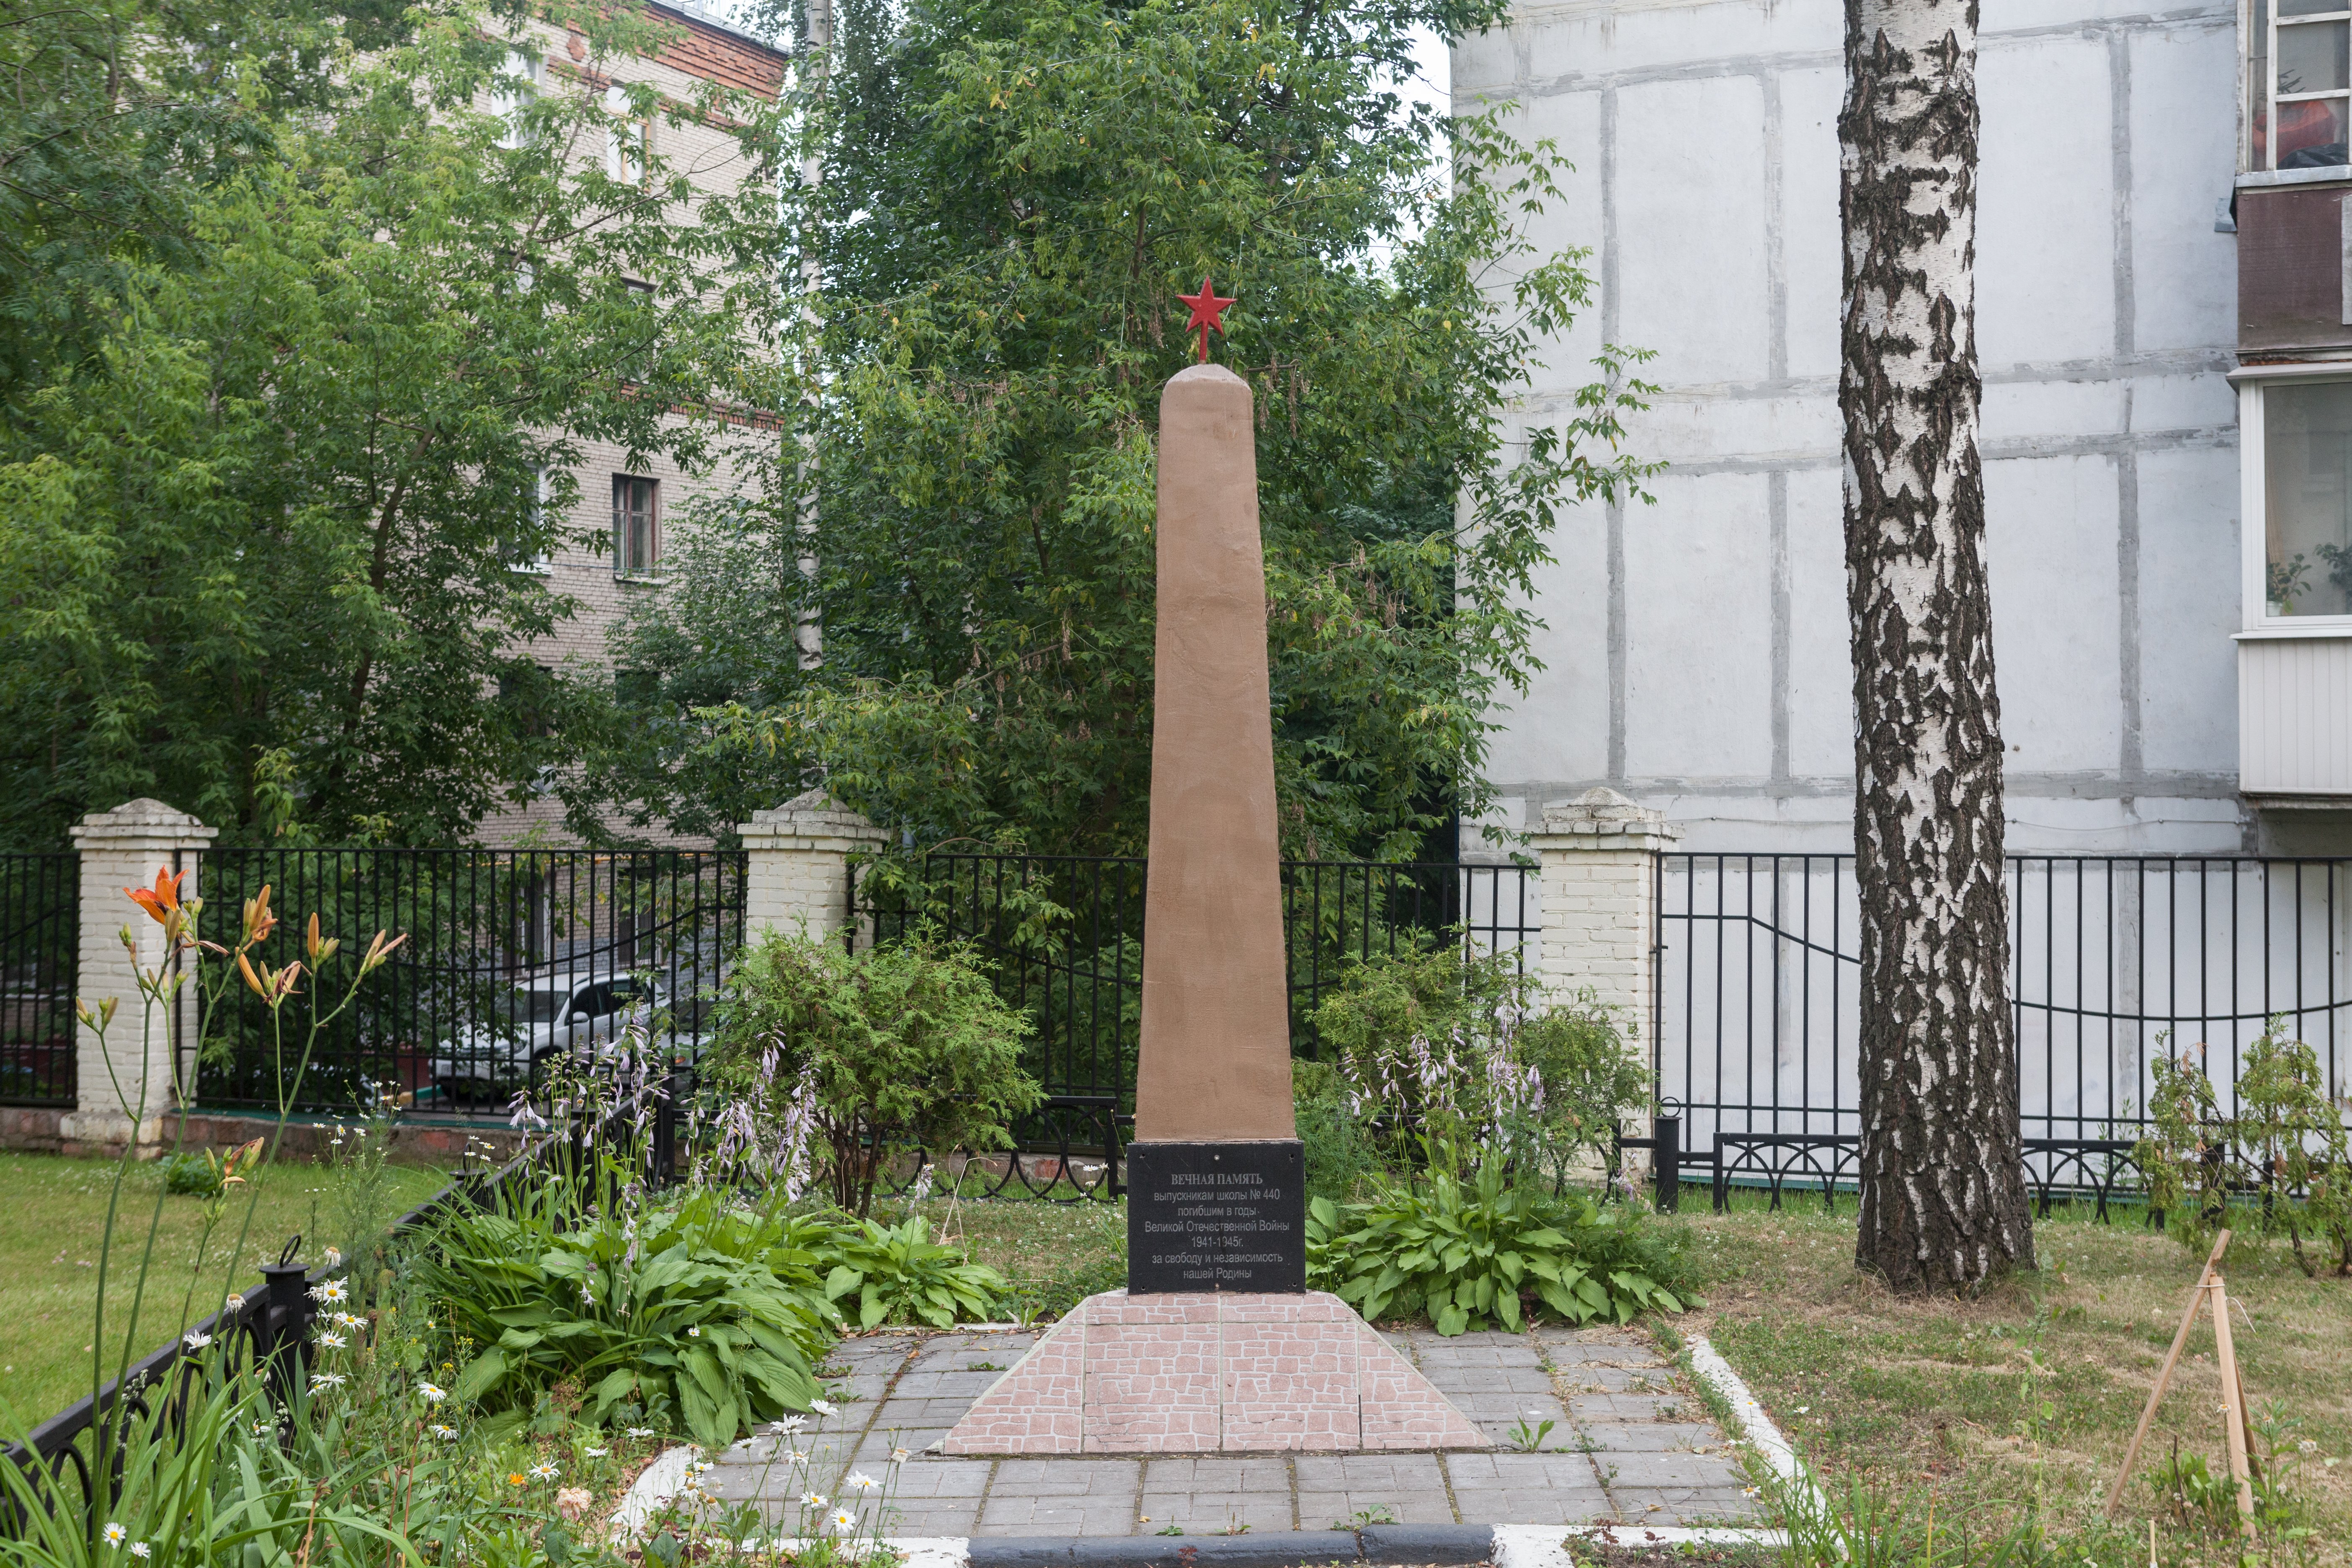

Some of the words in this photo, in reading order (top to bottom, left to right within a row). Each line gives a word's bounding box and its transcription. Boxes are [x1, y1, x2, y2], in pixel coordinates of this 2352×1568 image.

[1171, 1173, 1215, 1185] ВЕЧНАЯ
[1217, 1173, 1263, 1184] ПАМЯТЬ
[1154, 1191, 1214, 1203] выпускникам
[1217, 1191, 1247, 1200] школы
[1250, 1189, 1261, 1200] №
[1263, 1188, 1280, 1200] 440
[1178, 1204, 1224, 1216] погибшим
[1227, 1207, 1232, 1216] в
[1235, 1207, 1256, 1217] годы
[1145, 1220, 1184, 1232] Великой
[1186, 1220, 1257, 1232] Отечественной
[1259, 1219, 1289, 1231] Войны
[1191, 1236, 1243, 1247] 1941-1945г.
[1152, 1255, 1163, 1264] за
[1165, 1252, 1203, 1266] свободу
[1205, 1254, 1211, 1263] и
[1213, 1253, 1283, 1263] независимость
[1183, 1267, 1214, 1279] нашей
[1216, 1267, 1252, 1280] Родины
